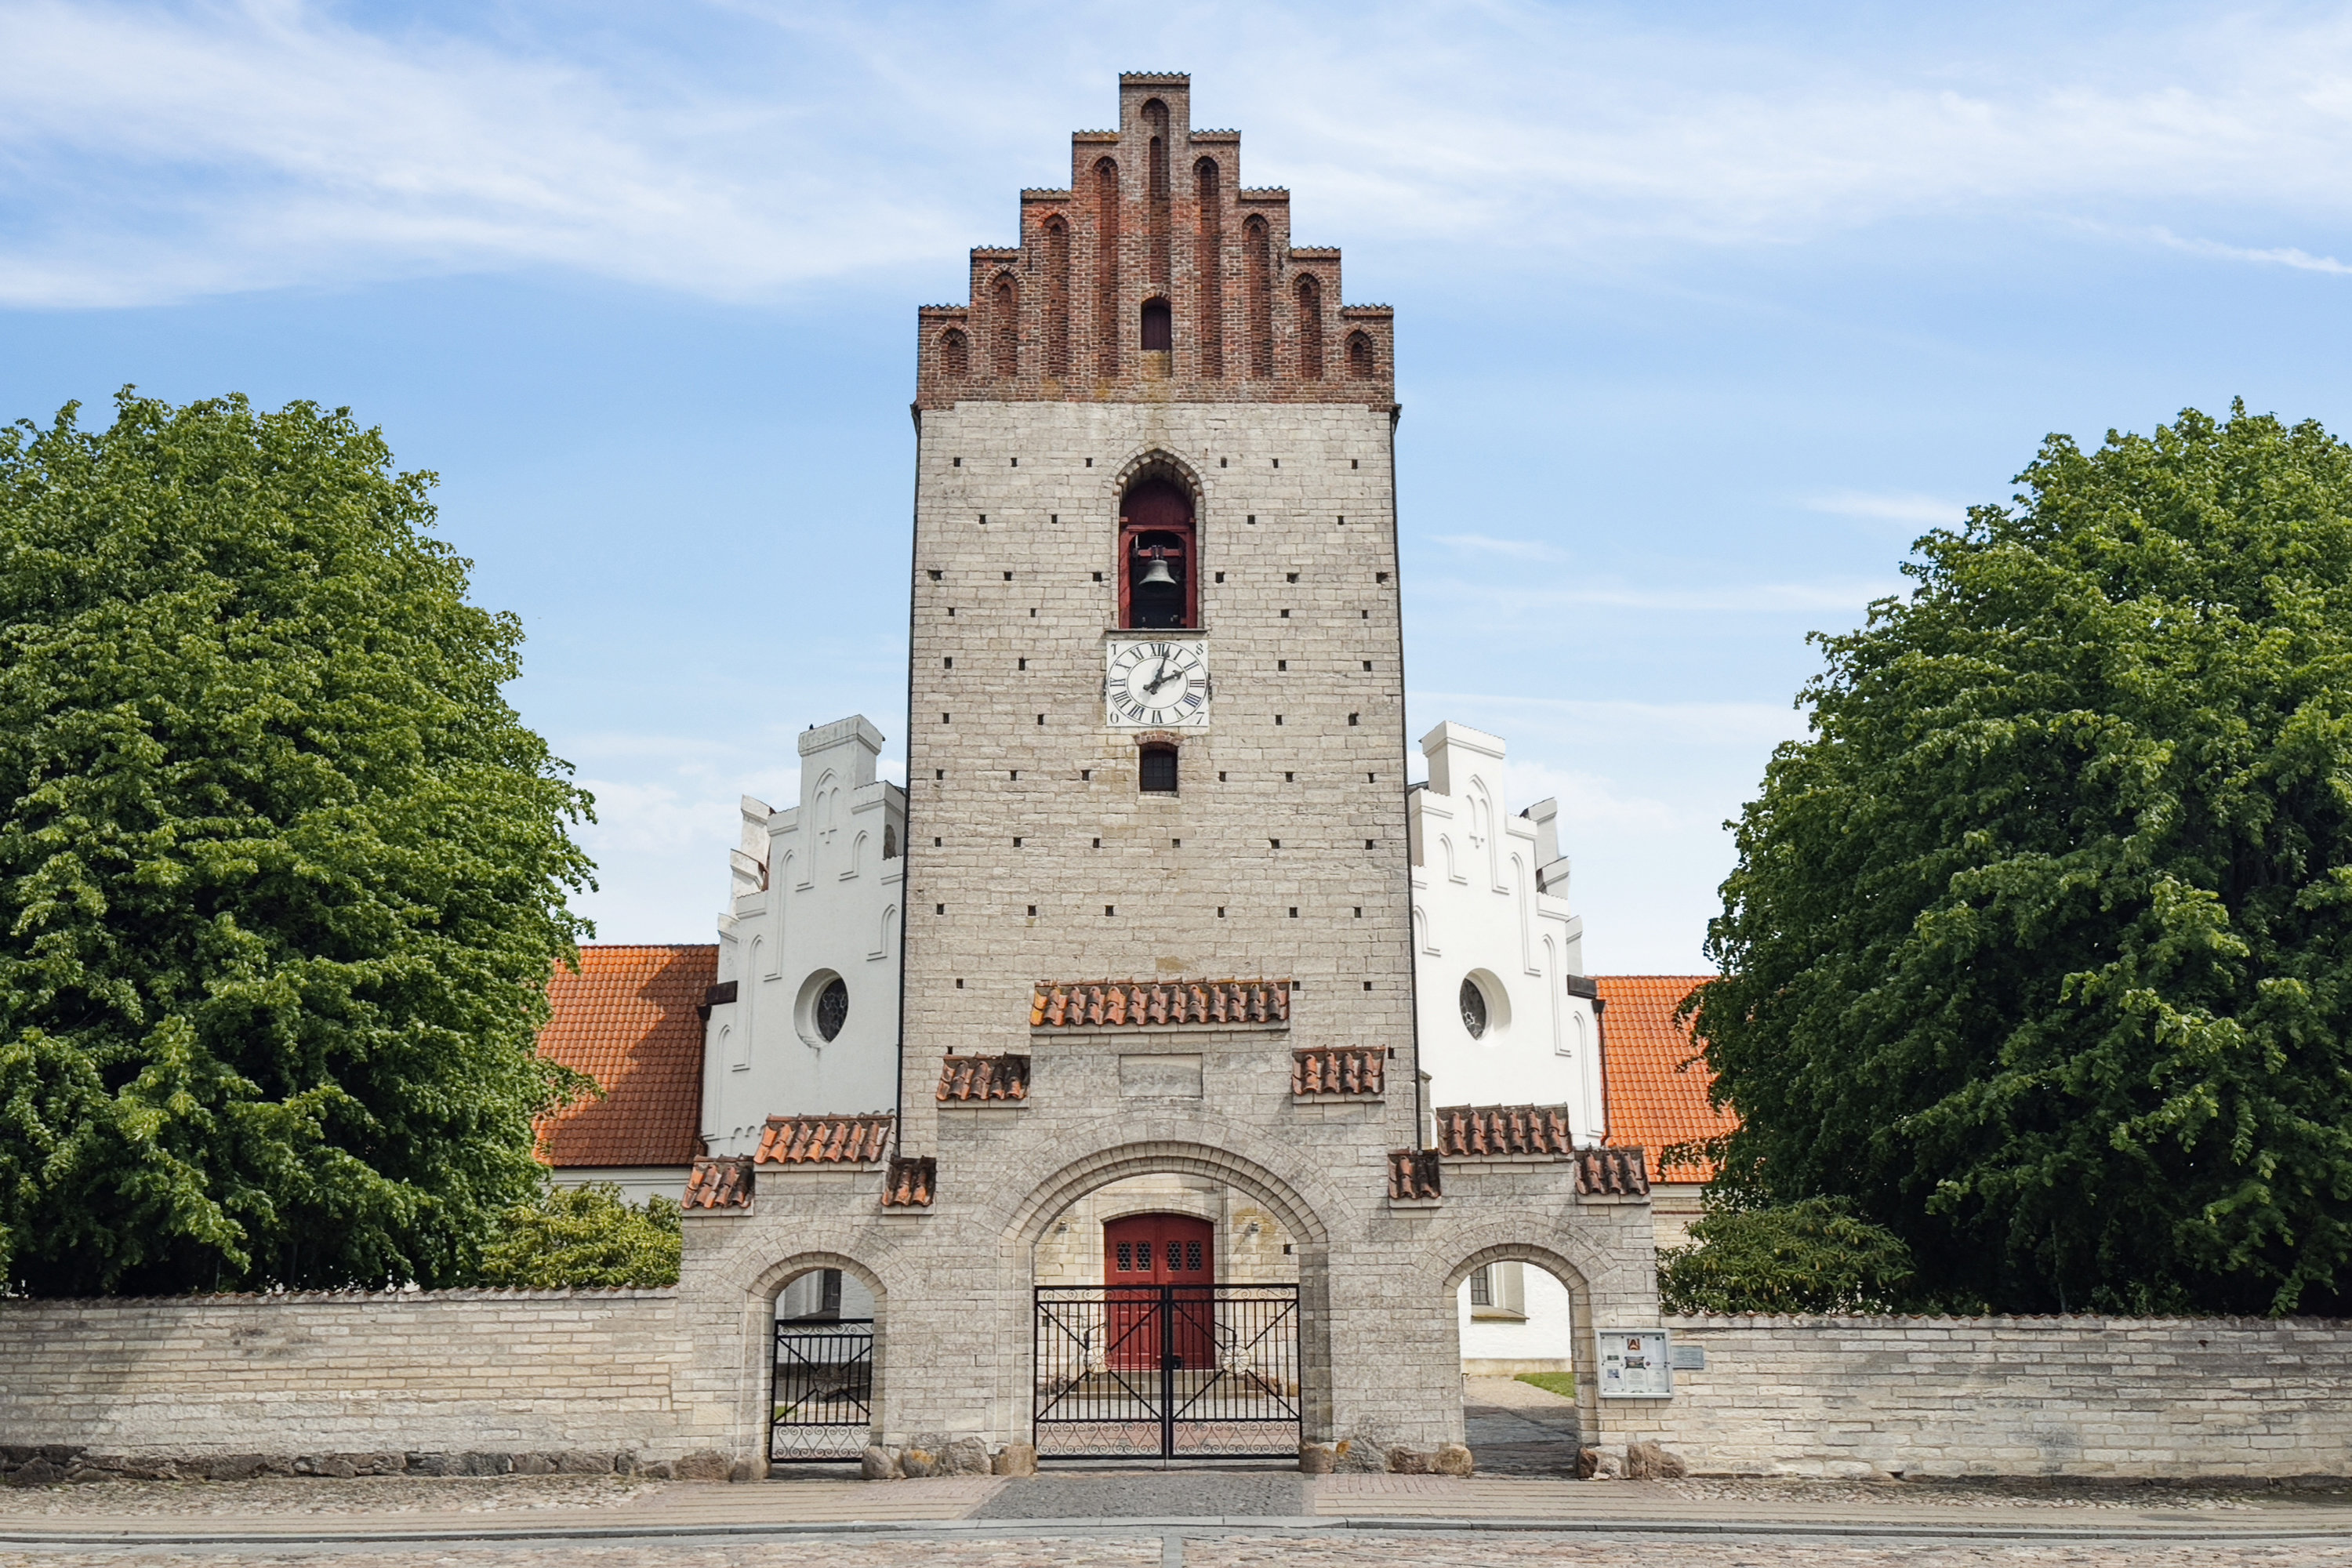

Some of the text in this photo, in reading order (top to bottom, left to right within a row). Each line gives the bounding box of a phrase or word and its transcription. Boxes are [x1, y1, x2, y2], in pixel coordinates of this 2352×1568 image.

[1129, 647, 1145, 662] XI
[1149, 643, 1167, 657] XII
[1173, 648, 1183, 660] I
[1196, 643, 1203, 655] 8
[1184, 660, 1200, 671] II
[1109, 677, 1126, 687] IX
[1189, 679, 1205, 688] III
[1109, 711, 1119, 724] 6
[1127, 704, 1145, 720] VII
[1151, 710, 1163, 724] VI
[1174, 706, 1185, 720] V
[1196, 712, 1204, 724] 7
